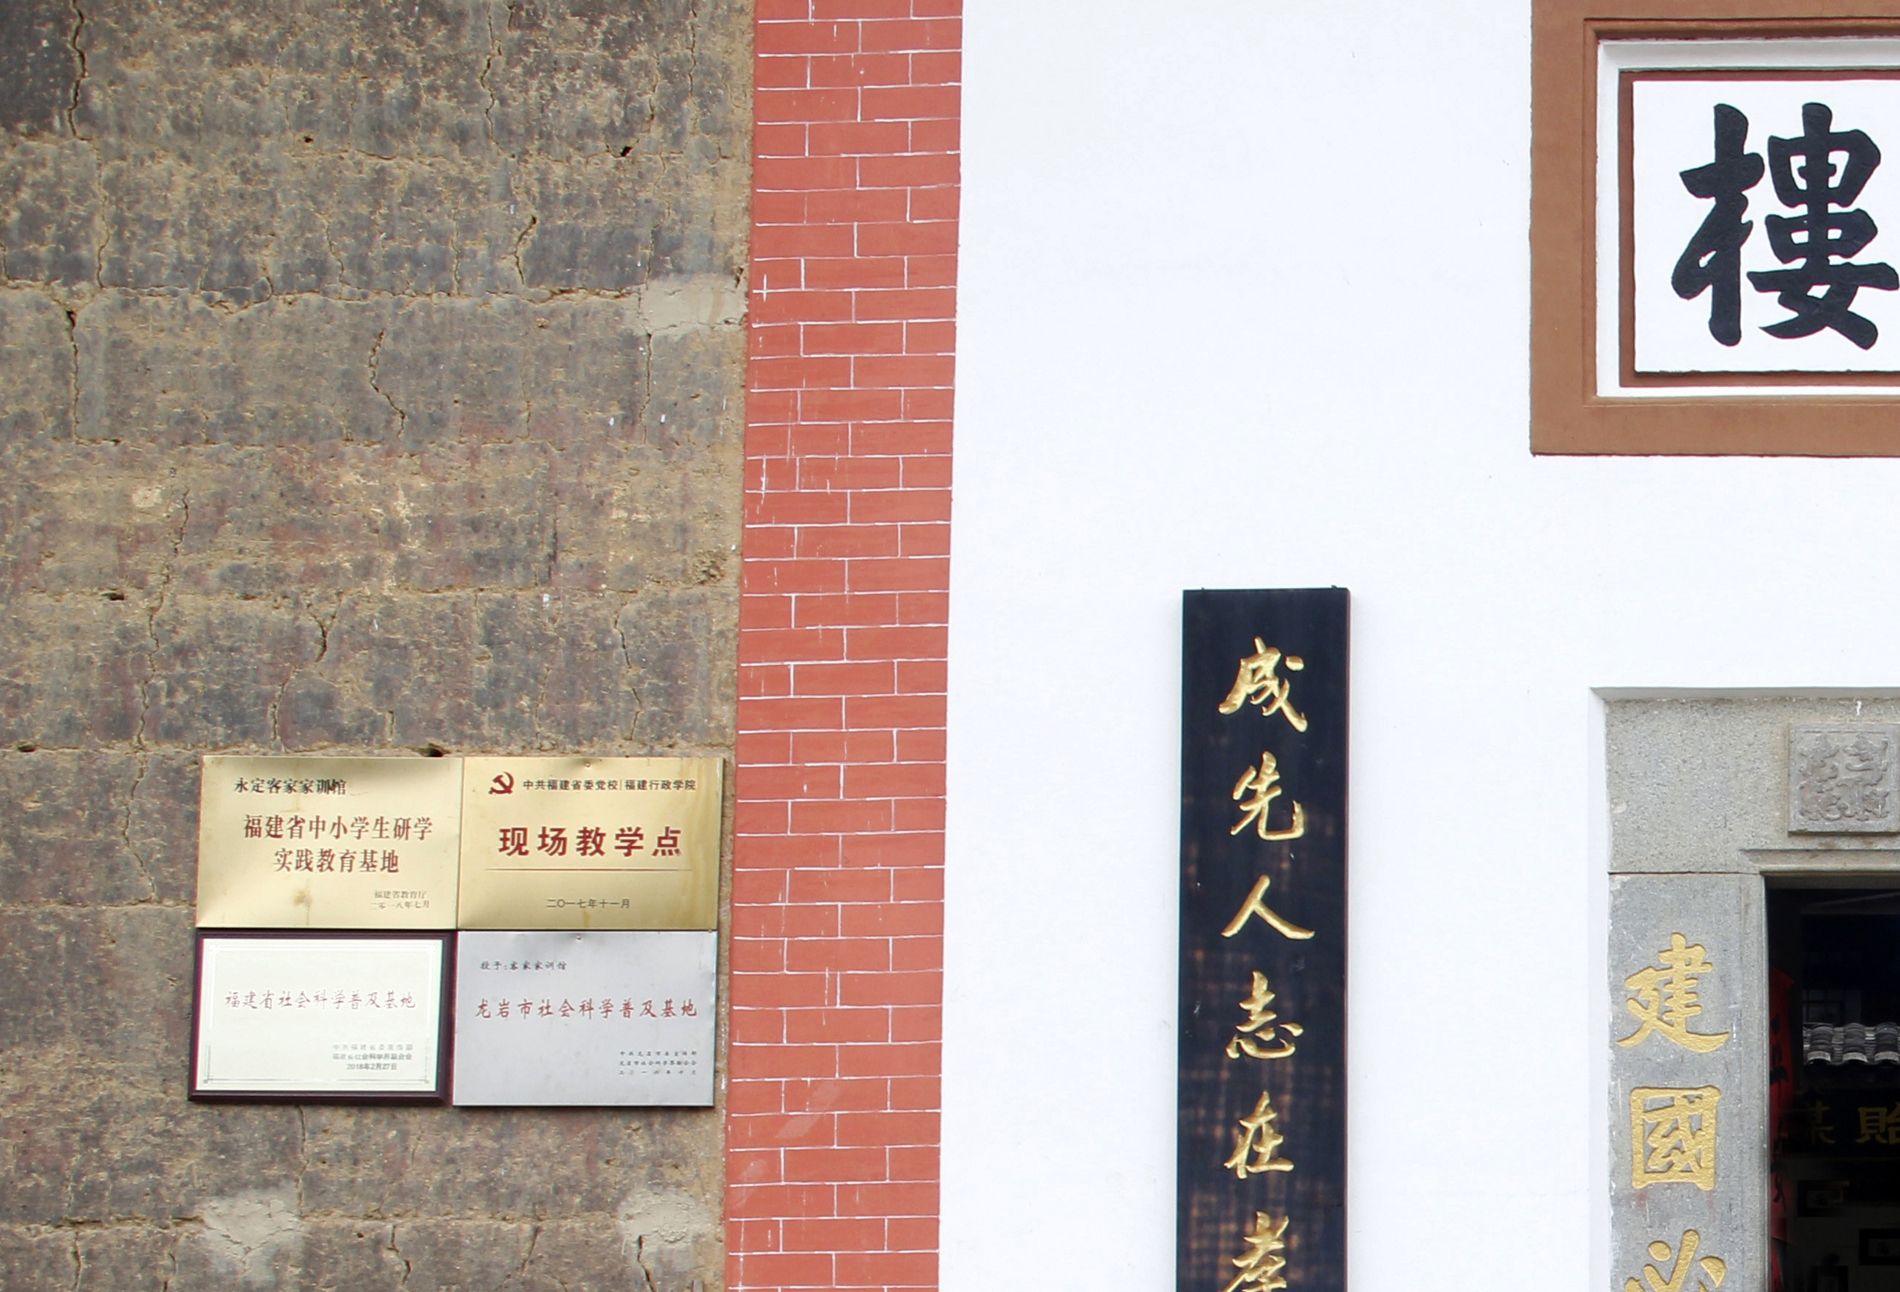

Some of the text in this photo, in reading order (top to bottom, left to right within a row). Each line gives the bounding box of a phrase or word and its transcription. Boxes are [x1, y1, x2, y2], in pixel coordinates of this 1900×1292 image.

[234, 777, 347, 795] 永定客家家训馆
[243, 814, 434, 841] 福建省中小学生研学
[498, 826, 682, 857] 现场教学点
[273, 848, 400, 873] 实践教育基地
[225, 990, 416, 1010] 福建省社会科学普及基地
[475, 998, 698, 1019] 龙岩市社会科学普及基地
